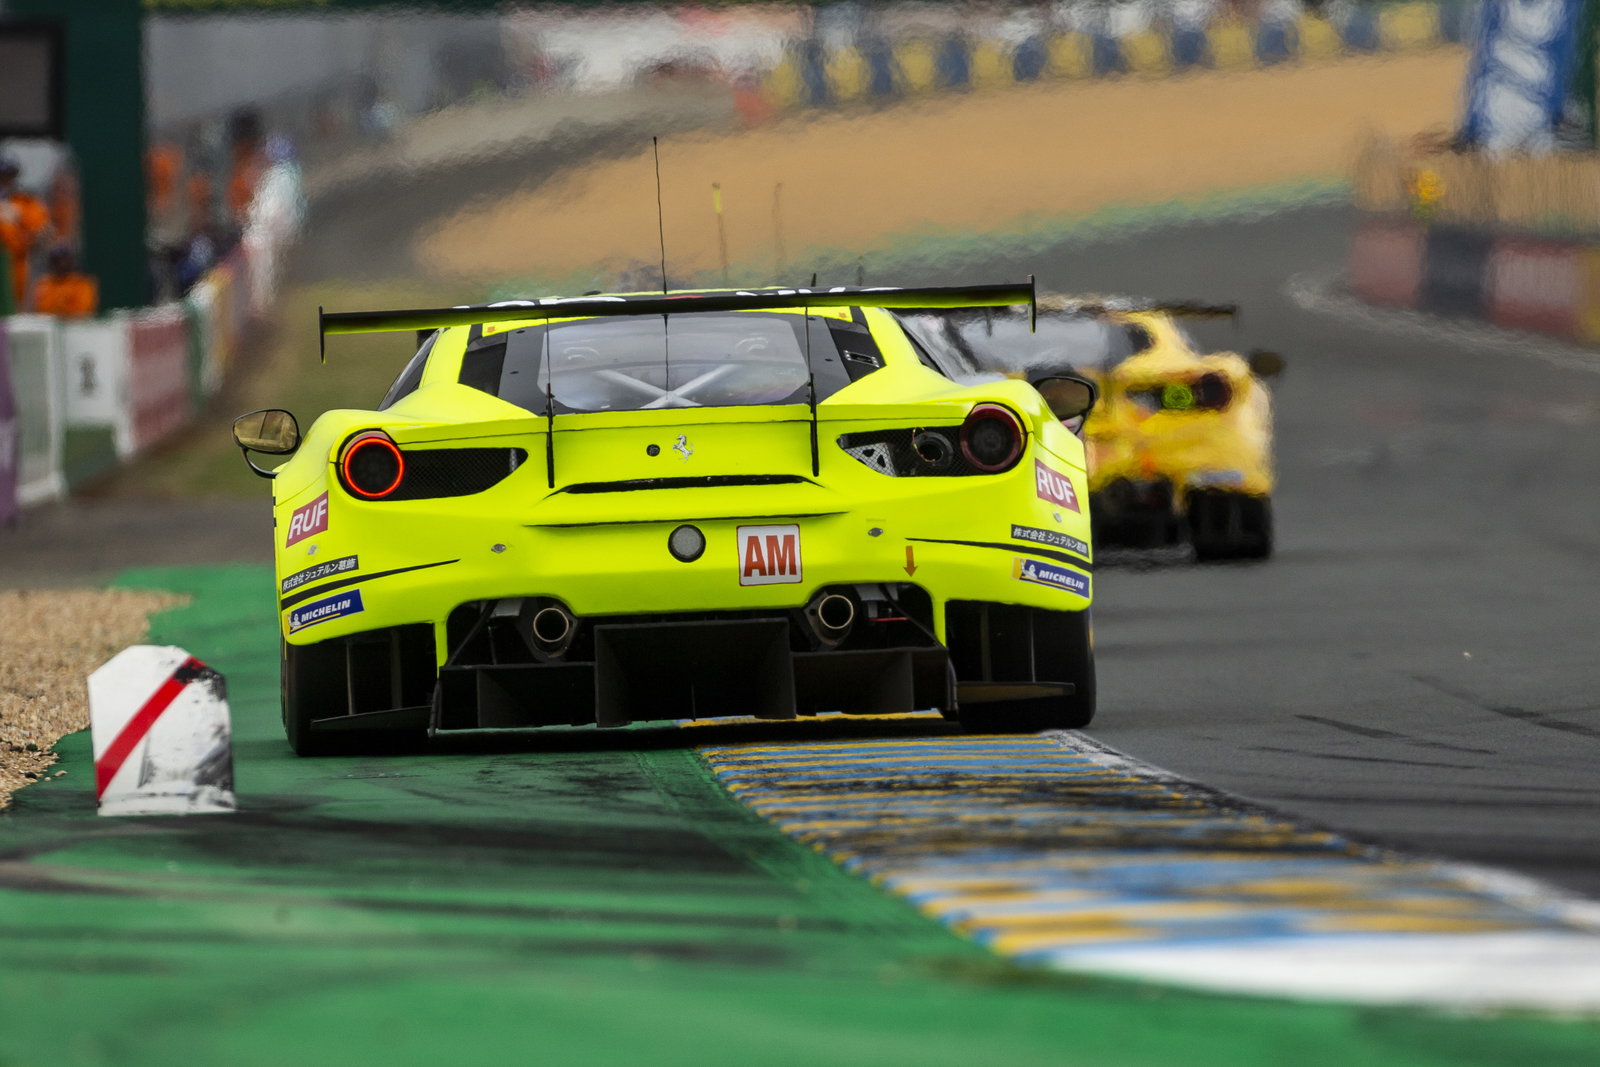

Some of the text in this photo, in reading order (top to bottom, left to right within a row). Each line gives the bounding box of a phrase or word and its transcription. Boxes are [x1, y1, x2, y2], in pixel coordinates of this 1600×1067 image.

[1036, 467, 1075, 504] RUF
[288, 499, 328, 539] RUF
[743, 534, 797, 577] AM
[1038, 570, 1085, 589] MICHELIN
[301, 599, 351, 622] MICHELIN
